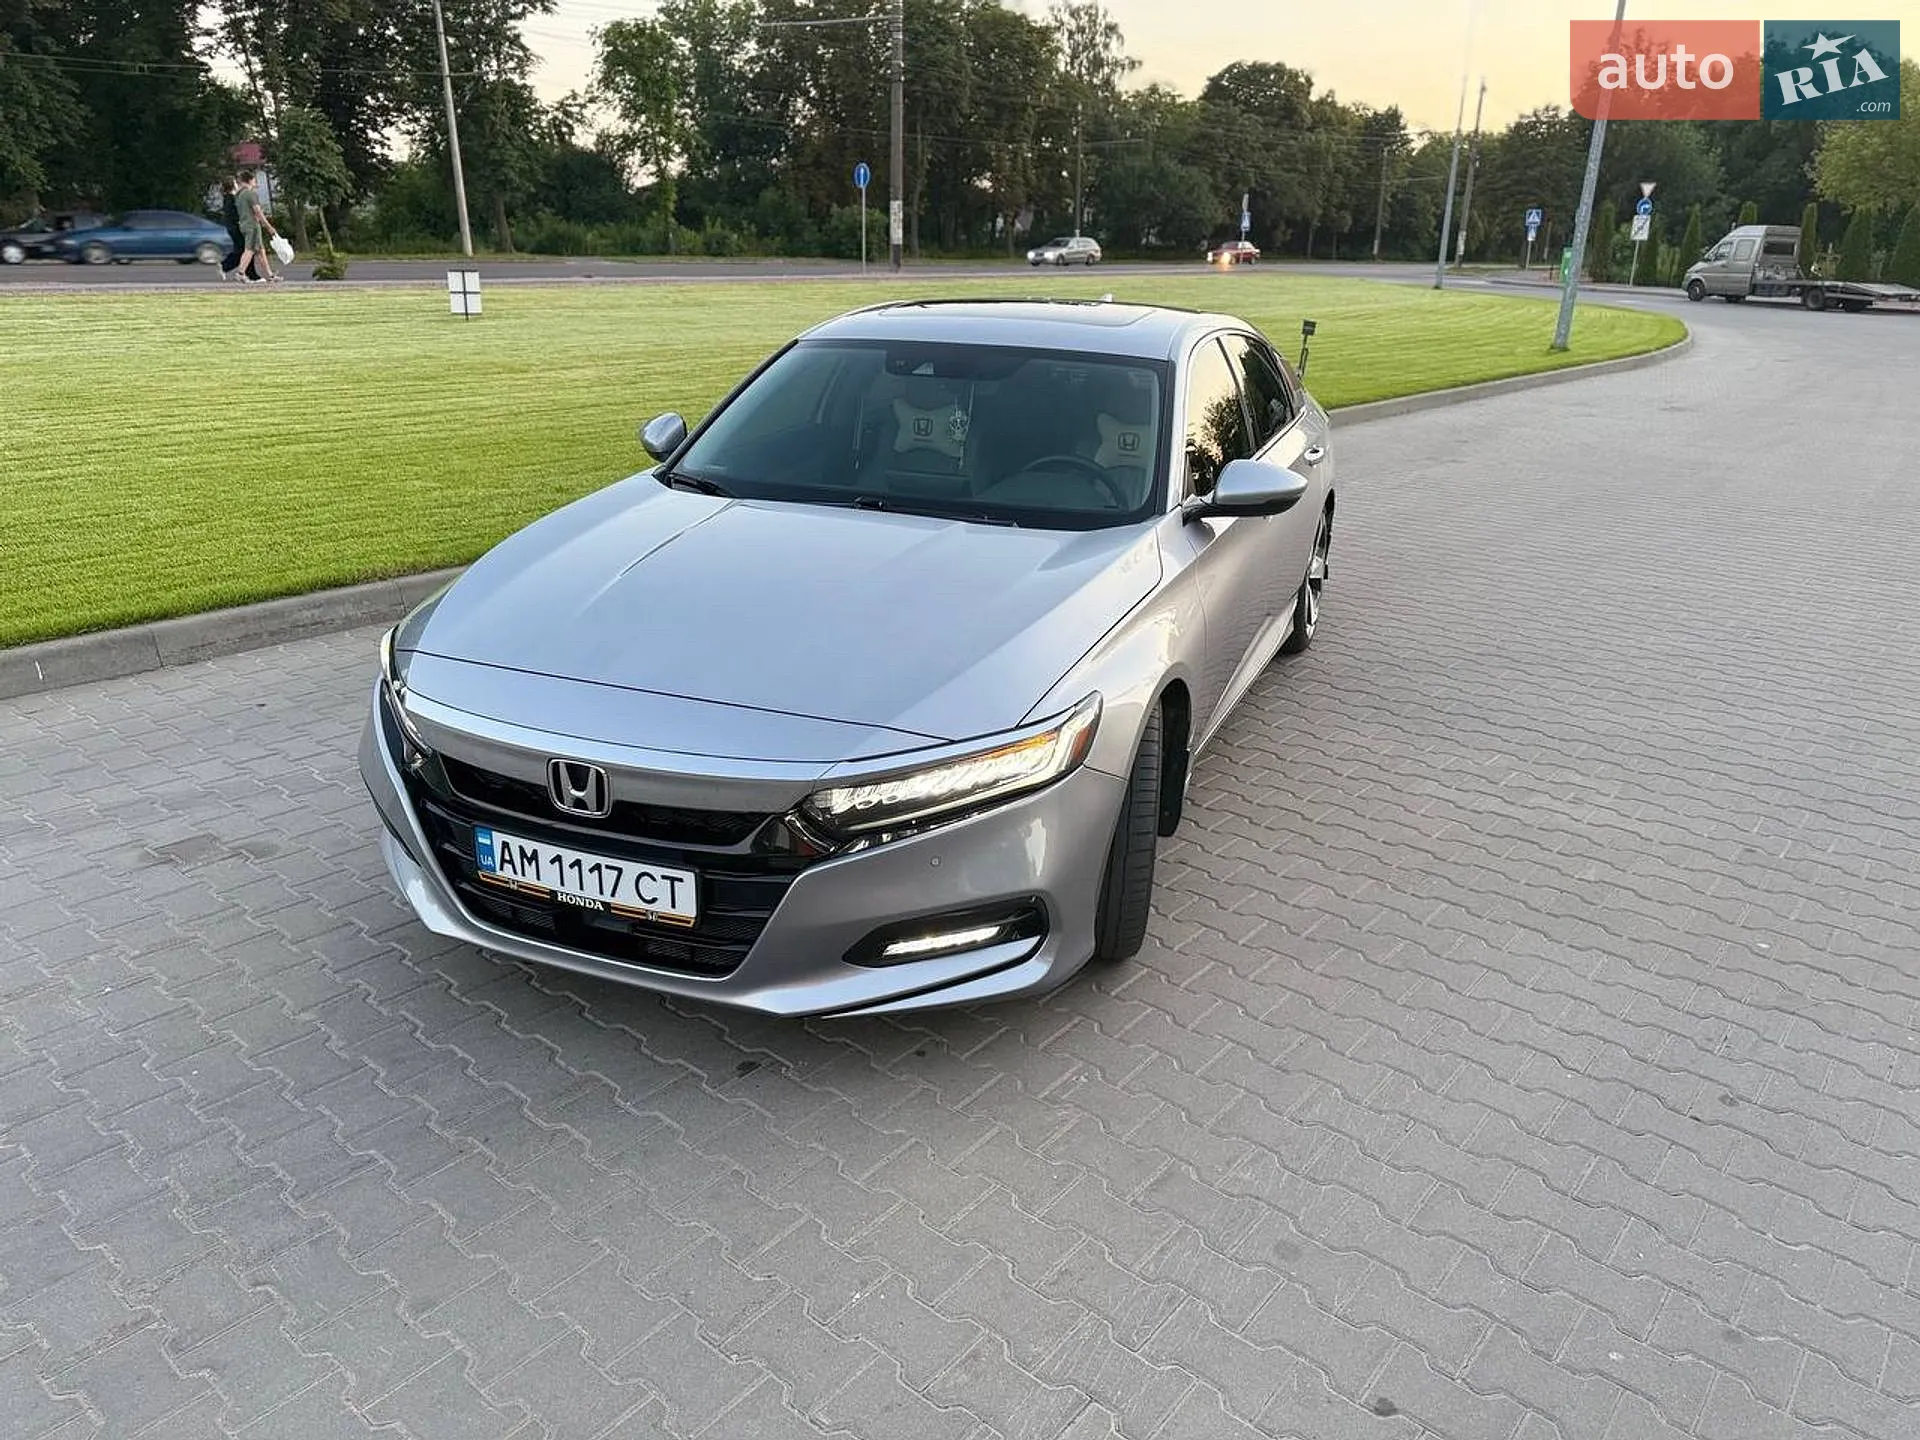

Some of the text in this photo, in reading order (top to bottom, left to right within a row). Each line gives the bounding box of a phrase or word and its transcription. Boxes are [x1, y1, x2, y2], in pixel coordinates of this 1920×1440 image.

[480, 854, 495, 867] UA
[500, 840, 684, 909] AM 1117 CT
[557, 892, 604, 911] HONDA
